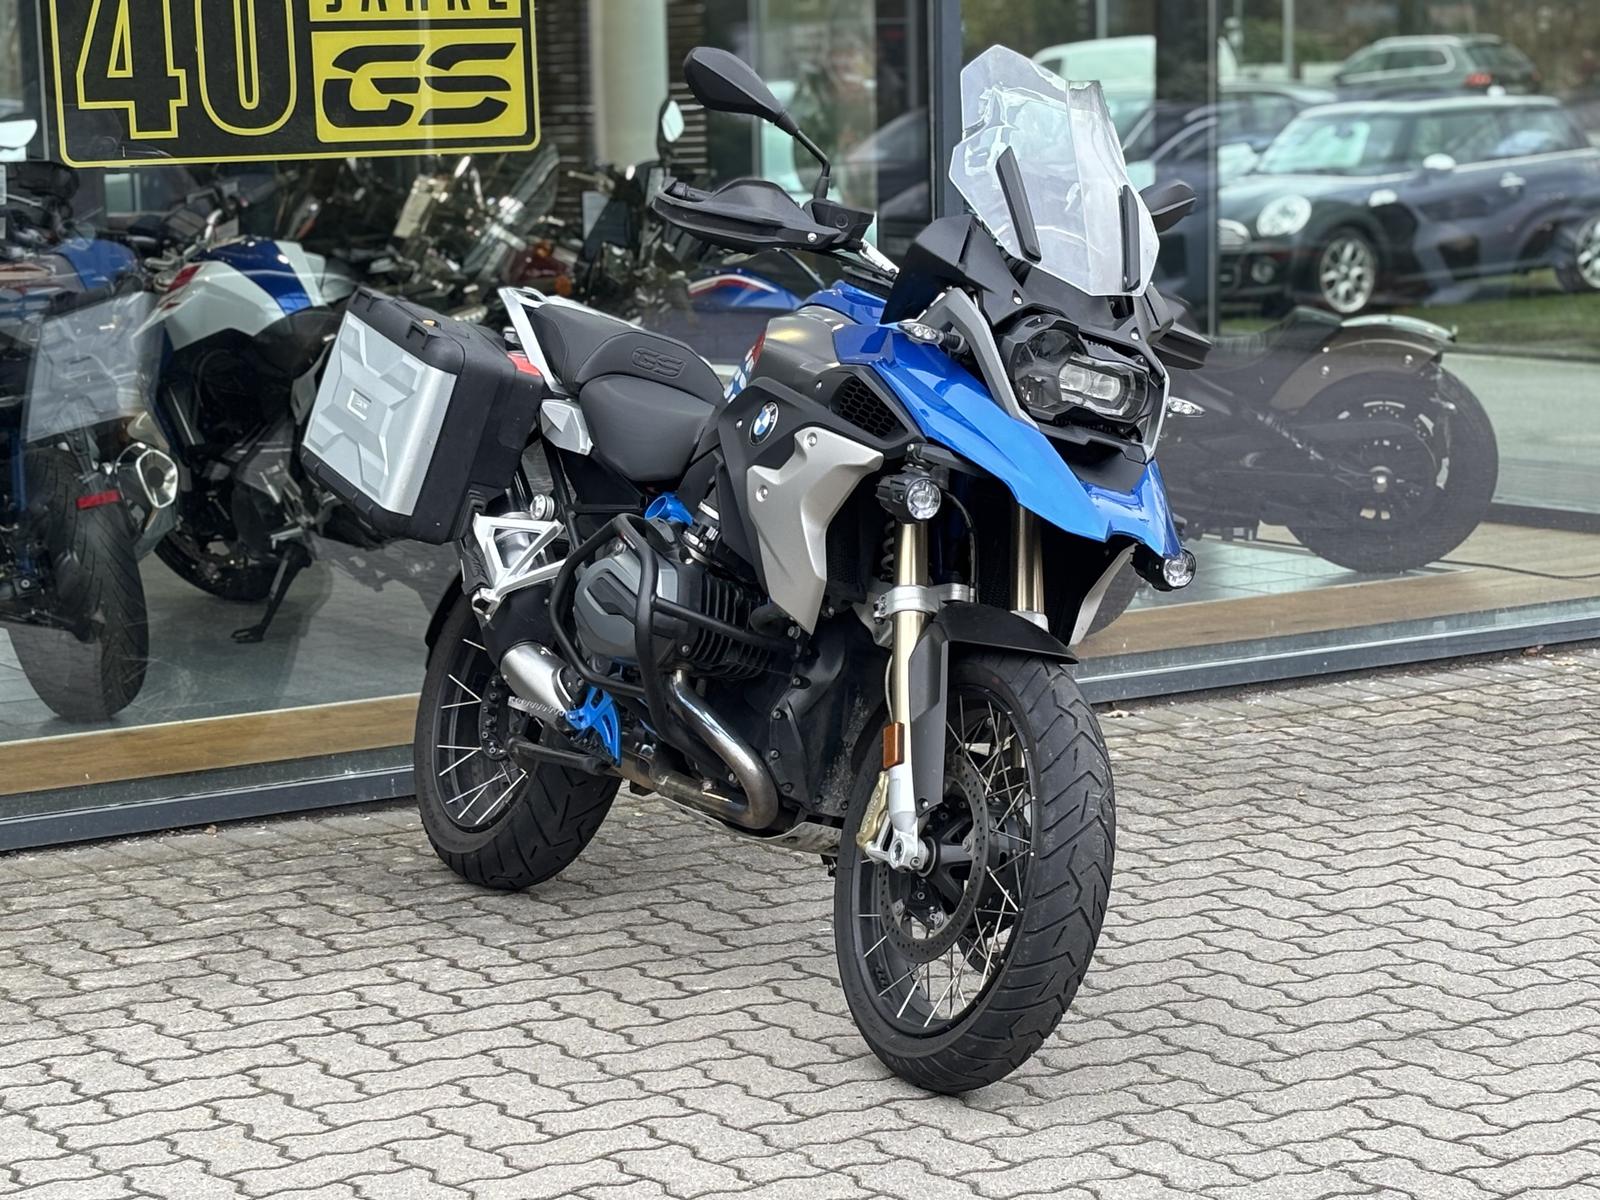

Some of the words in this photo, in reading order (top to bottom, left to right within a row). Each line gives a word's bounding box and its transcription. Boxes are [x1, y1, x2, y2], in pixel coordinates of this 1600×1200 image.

[76, 0, 298, 140] 40
[322, 42, 517, 128] GS
[632, 349, 684, 378] GS
